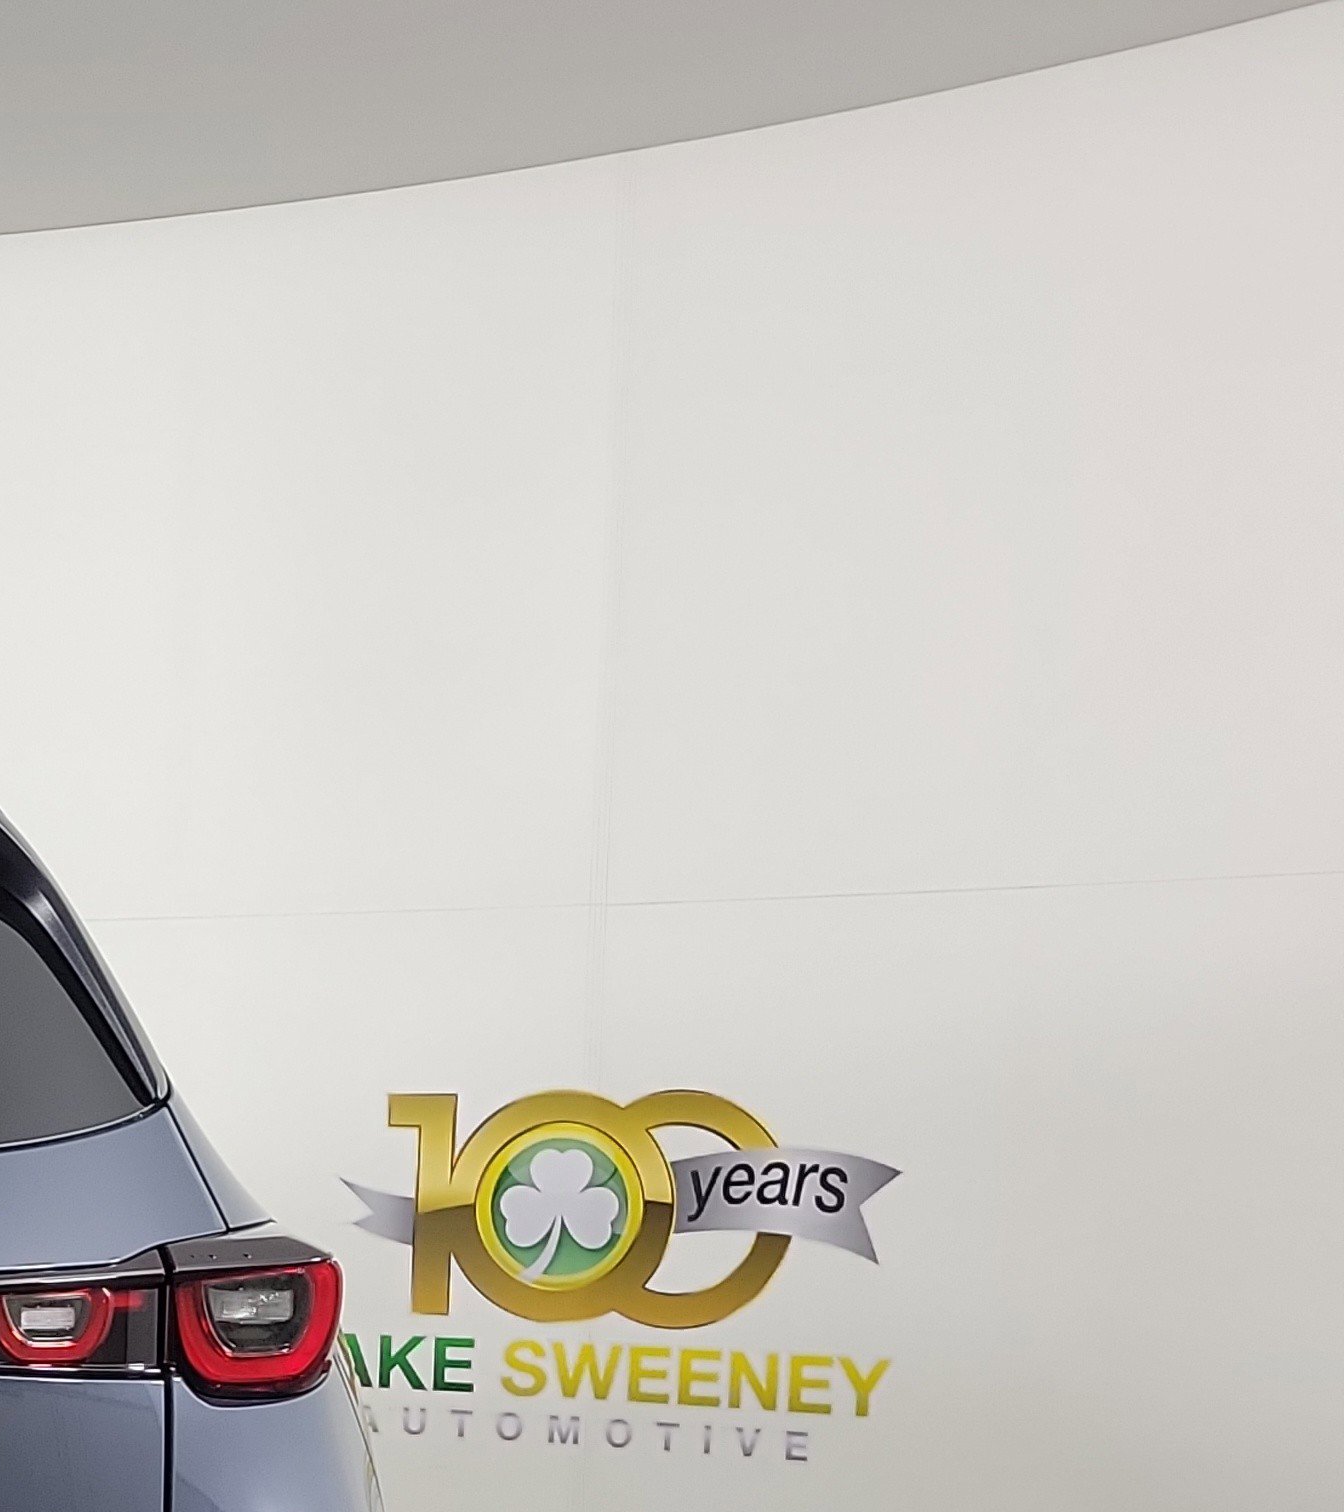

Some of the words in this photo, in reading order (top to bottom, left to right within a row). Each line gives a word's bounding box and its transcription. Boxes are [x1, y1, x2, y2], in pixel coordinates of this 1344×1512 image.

[387, 1088, 793, 1330] 100
[686, 1160, 849, 1222] years
[500, 1339, 892, 1418] SWEENEY
